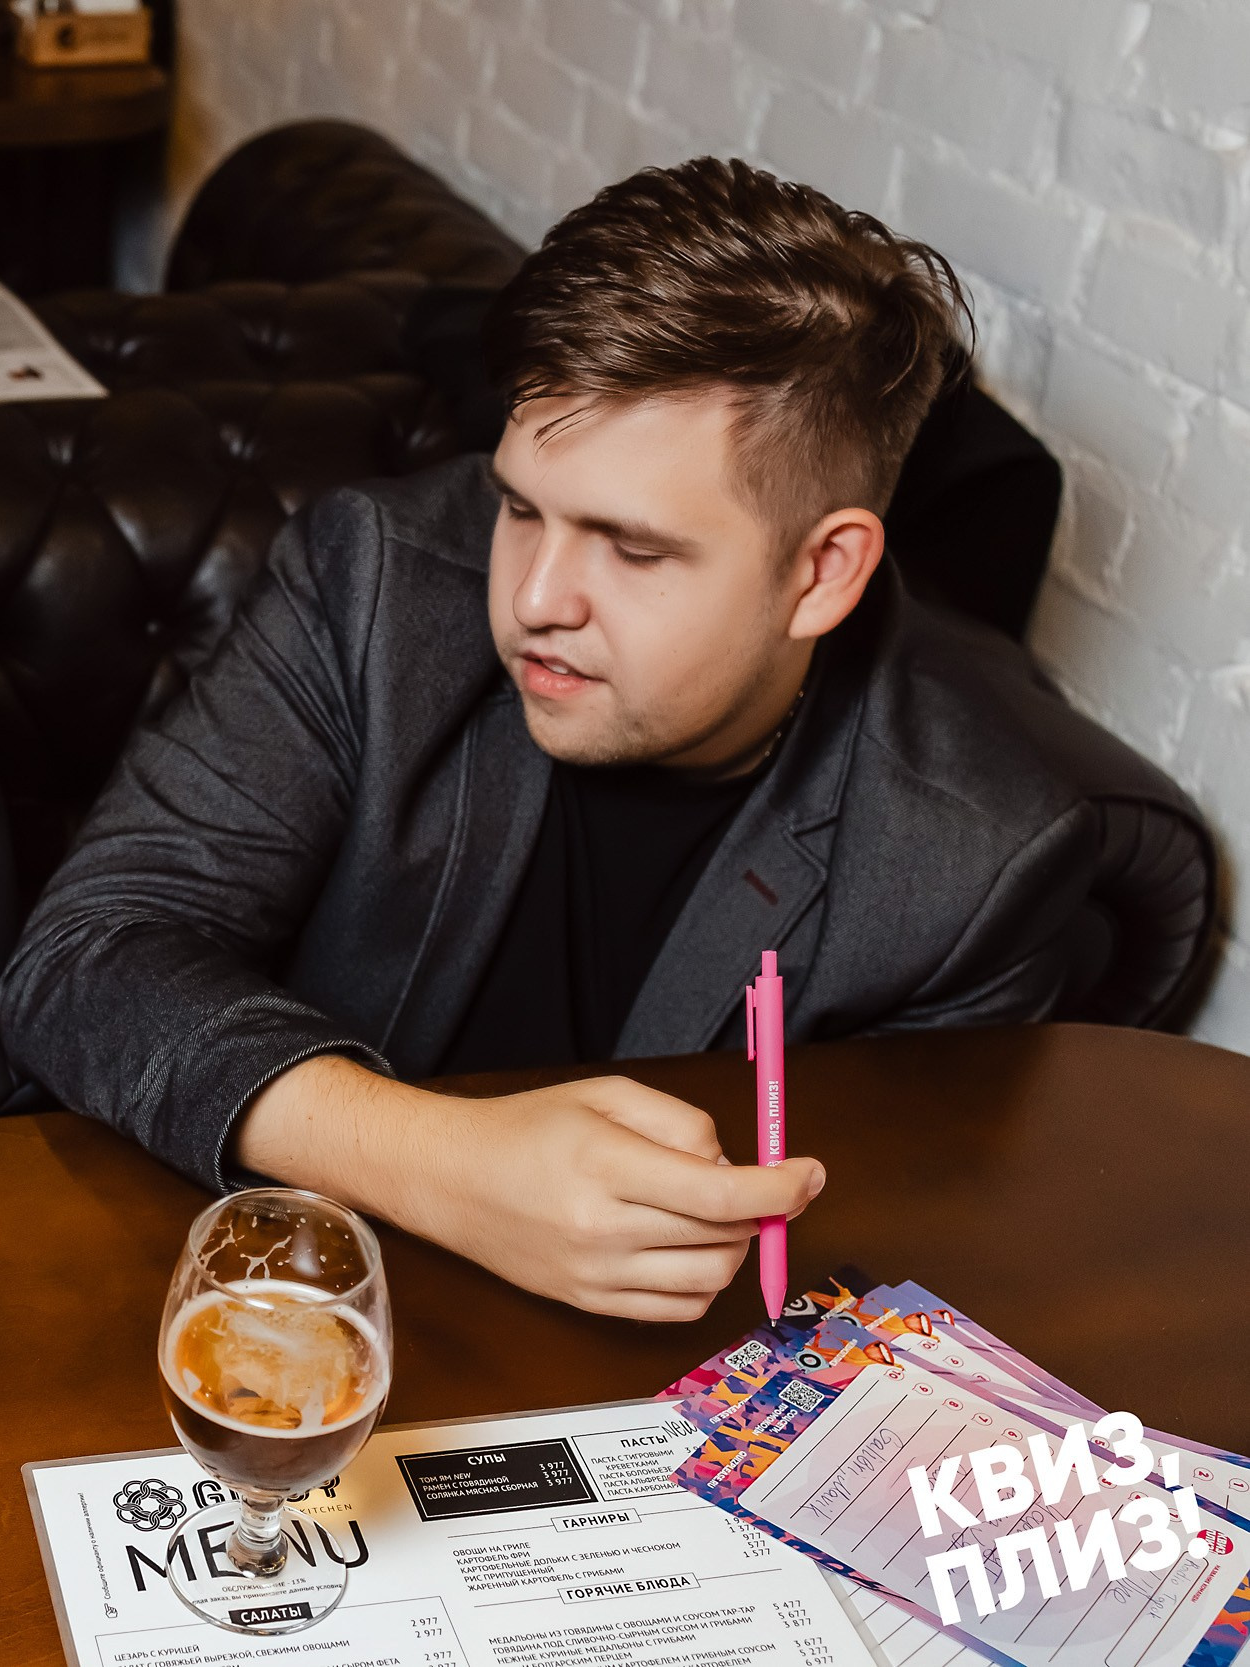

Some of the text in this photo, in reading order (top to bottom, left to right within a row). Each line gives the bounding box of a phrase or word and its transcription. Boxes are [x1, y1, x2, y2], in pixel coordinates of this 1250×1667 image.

[768, 1080, 781, 1155] КВИЗ, ПЛИЗ!
[888, 1370, 901, 1380] 10
[948, 1400, 959, 1408] 8
[752, 1403, 788, 1436] ПРОМОКОДЫ
[770, 1409, 798, 1434] СОЦСЕТИ,
[620, 1435, 668, 1448] ПАСТЫ
[468, 1453, 506, 1466] СУПЫ
[591, 1456, 618, 1464] ПАСТА
[625, 1450, 674, 1460] ТИГРОВЫМИ
[548, 1461, 565, 1470] 977
[606, 1460, 659, 1471] КРЕВЕТКАМИ
[707, 1450, 748, 1488] QUIZPLEASE.RU
[419, 1472, 471, 1484] ТОМ ЯМ NEW
[542, 1469, 569, 1479] 3 977
[599, 1466, 673, 1480] ПАСТА БОЛОНЬЕЗЕ
[1198, 1470, 1209, 1478] 2
[423, 1484, 450, 1492] РАМЕН
[459, 1476, 510, 1488] ГОВЯДИНОЙ
[546, 1477, 573, 1487] 3 977
[604, 1480, 630, 1488] ПАСТА
[1234, 1480, 1244, 1488] 1
[426, 1482, 538, 1500] СОЛЯНКА МЯСНАЯ СБОРНАЯ
[608, 1488, 634, 1496] ПАСТА
[299, 1504, 353, 1516] KITCHEN
[562, 1512, 630, 1528] ГАРНИРЫ
[743, 1532, 762, 1541] 977
[452, 1542, 530, 1557] ОВОЩИ НА ГРИЛЕ
[748, 1540, 766, 1549] 577
[125, 1520, 369, 1593] MENU
[456, 1551, 530, 1566] КАРТОФЕЛЬ ФРИ
[460, 1560, 531, 1574] КАРТОФЕЛЬНЫЕ
[534, 1556, 570, 1567] ДОЛЬКИ
[580, 1550, 621, 1560] ЗЕЛЕНЬЮ
[631, 1542, 681, 1554] ЧЕСНОКОМ
[754, 1548, 770, 1557] 577
[464, 1566, 554, 1584] РИС ПРИПУЩЕННЫЙ
[468, 1578, 520, 1592] ЖАРЕННЫЙ
[522, 1573, 574, 1586] КАРТОФЕЛЬ
[584, 1567, 625, 1578] ГРИБАМИ
[566, 1576, 690, 1600] ГОРЯЧИЕ БЛЮДА
[772, 1600, 801, 1610] 5 477
[241, 1607, 302, 1624] САЛАТЫ
[778, 1609, 806, 1620] 5 677
[420, 1617, 438, 1626] 977
[488, 1632, 548, 1646] МЕДАЛЬОНЫ
[549, 1630, 562, 1638] ИЗ
[563, 1624, 614, 1636] ГОВЯДИНЫ
[616, 1622, 622, 1630] С
[623, 1617, 672, 1629] ОВОЩАМИ
[682, 1610, 720, 1622] СОУСОМ
[722, 1606, 756, 1616] ТАР-ТАР
[783, 1618, 812, 1628] 3 877
[415, 1628, 442, 1638] 2 977
[493, 1642, 542, 1655] ГОВЯДИНА
[544, 1640, 564, 1648] ПОД
[565, 1627, 660, 1646] СЛИВОЧНО-СЫРНЫМ
[662, 1623, 700, 1634] СОУСОМ
[710, 1616, 752, 1628] ГРИБАМИ
[794, 1637, 822, 1648] 3 677
[114, 1644, 200, 1662] ЦЕЗАРЬ С КУРИЦЕЙ
[155, 1640, 350, 1667] ГОВЯЖЬЕЙ ВЫРЕЗКОЙ, СВЕЖИМИ ОВОЩАМИ
[434, 1650, 452, 1660] 977
[497, 1654, 538, 1664] НЕЖНЫЕ
[539, 1648, 583, 1660] КУРИНЫЕ
[585, 1642, 644, 1654] МЕДАЛЬОНЫ
[652, 1634, 696, 1646] ГРИБАМИ
[691, 1649, 736, 1661] ГРИБНЫМ
[738, 1644, 776, 1654] СОУСОМ
[809, 1646, 828, 1656] 277
[376, 1658, 400, 1666] ФЕТА
[594, 1652, 632, 1663] ПЕРЦЕМ
[806, 1656, 833, 1666] 6 977
